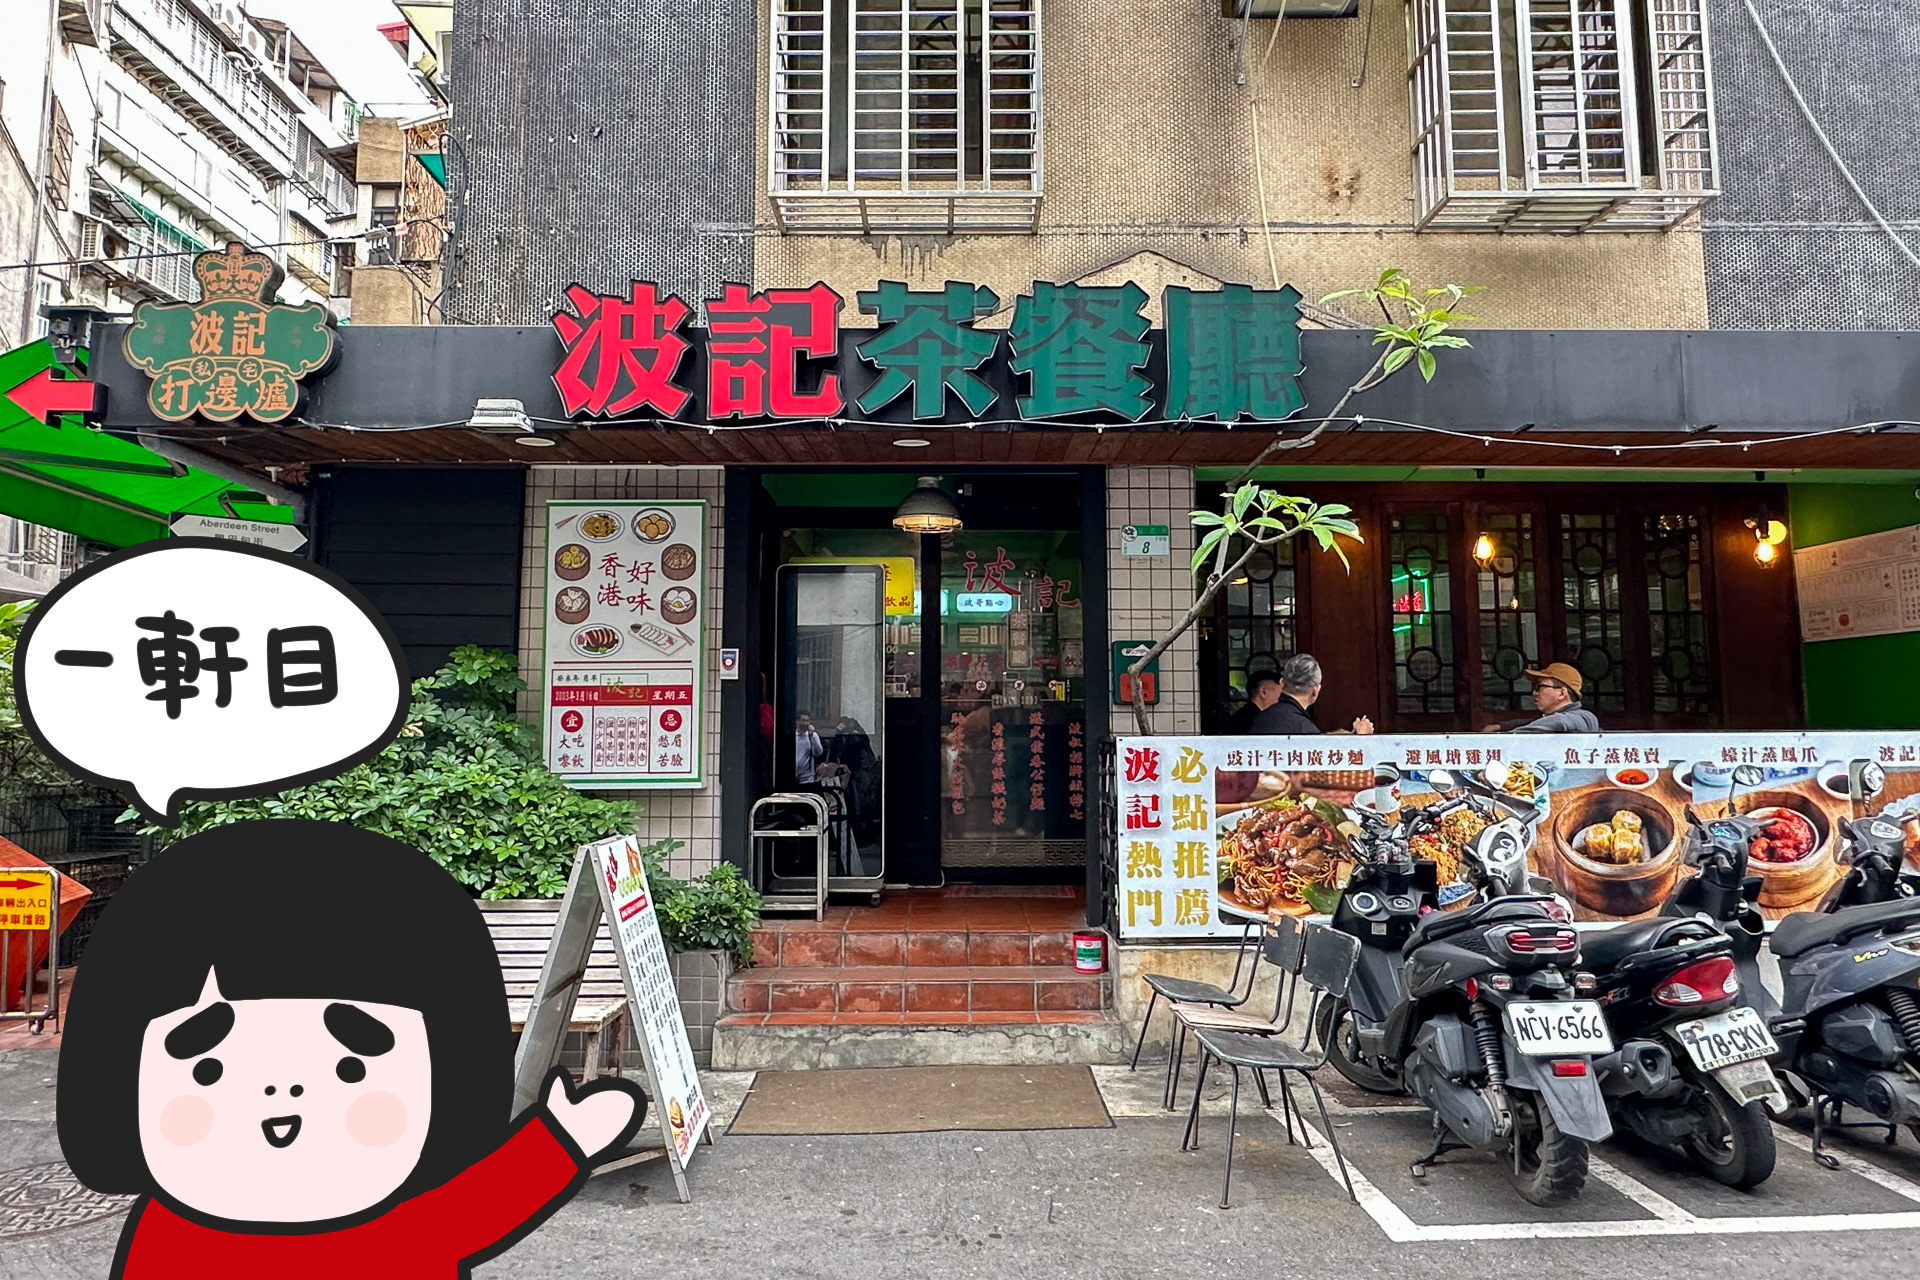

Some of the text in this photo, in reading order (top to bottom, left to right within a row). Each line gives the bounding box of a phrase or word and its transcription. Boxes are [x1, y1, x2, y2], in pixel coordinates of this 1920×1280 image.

[189, 310, 267, 355] 波記
[551, 280, 1306, 420] 波記茶餐廳
[195, 361, 258, 377] 私宅
[157, 372, 293, 412] 打邊爐
[199, 519, 280, 534] Aberdeen Street
[1141, 541, 1151, 554] 8
[598, 552, 626, 608] 香港
[963, 546, 1080, 608] 波記
[626, 560, 657, 616] 好味
[606, 677, 644, 699] 波記
[652, 690, 688, 701] 星期五
[566, 714, 579, 728] 宜
[664, 714, 678, 727] 忌
[1564, 747, 1660, 764] 魚子蒸燒賣
[1721, 746, 1818, 763] 蠔汁蒸鳳爪
[1879, 746, 1920, 762] 波記
[1124, 747, 1163, 927] 波記熱門
[1171, 746, 1211, 926] 必點推薦
